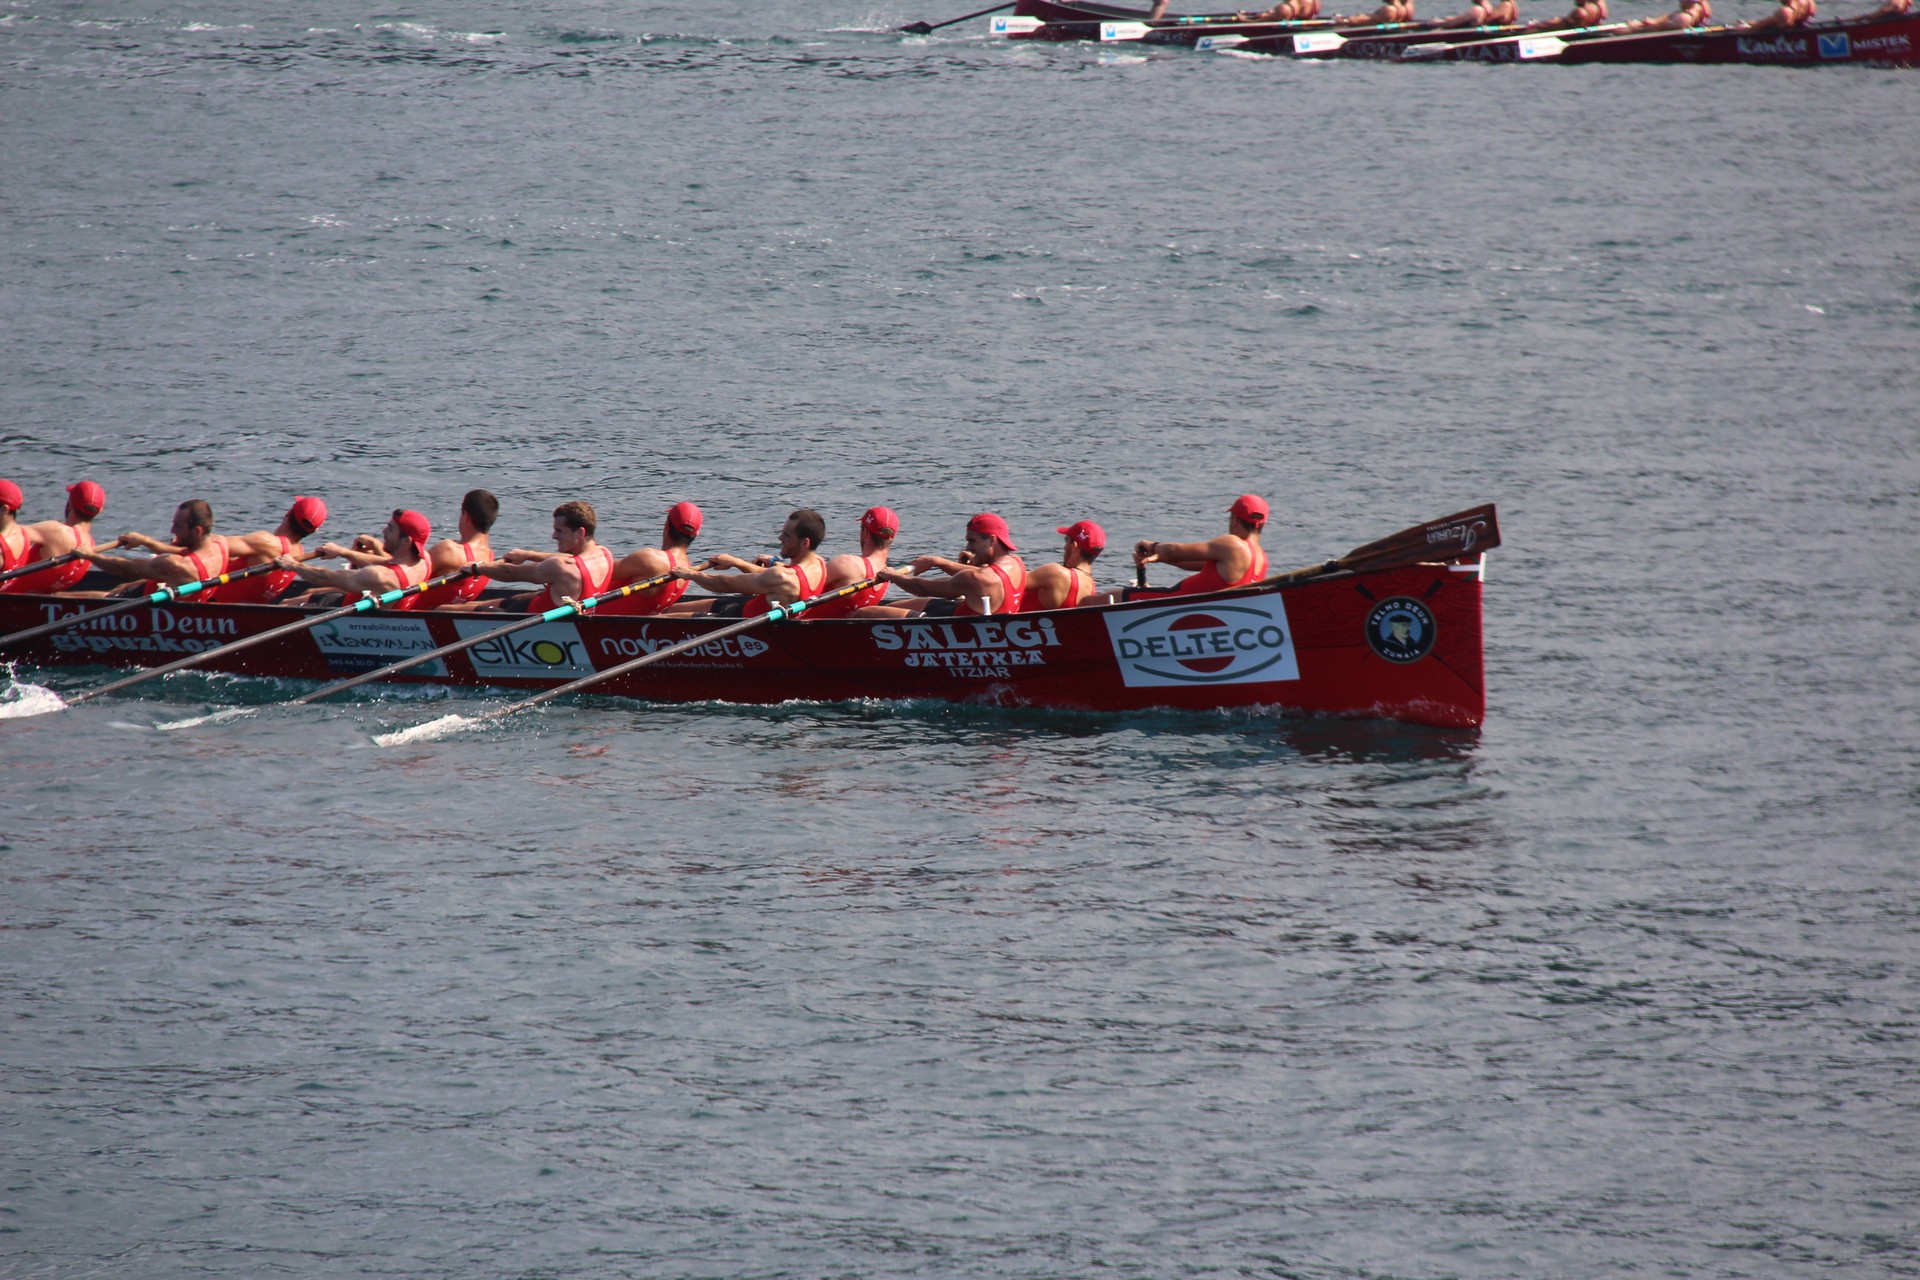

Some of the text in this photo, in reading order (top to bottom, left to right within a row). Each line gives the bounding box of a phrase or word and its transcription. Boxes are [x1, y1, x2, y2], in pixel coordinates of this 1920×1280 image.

[1853, 34, 1911, 50] MISTEK
[151, 606, 238, 635] Deun
[1371, 602, 1429, 625] TELMO DEUN
[50, 630, 224, 654] gipuzkoa
[471, 631, 580, 666] elkor
[1117, 625, 1285, 659] DELTECO
[1383, 648, 1421, 659] ZUMAIA
[904, 650, 1046, 667] JATETXEA
[950, 667, 1011, 679] ITZIAR
